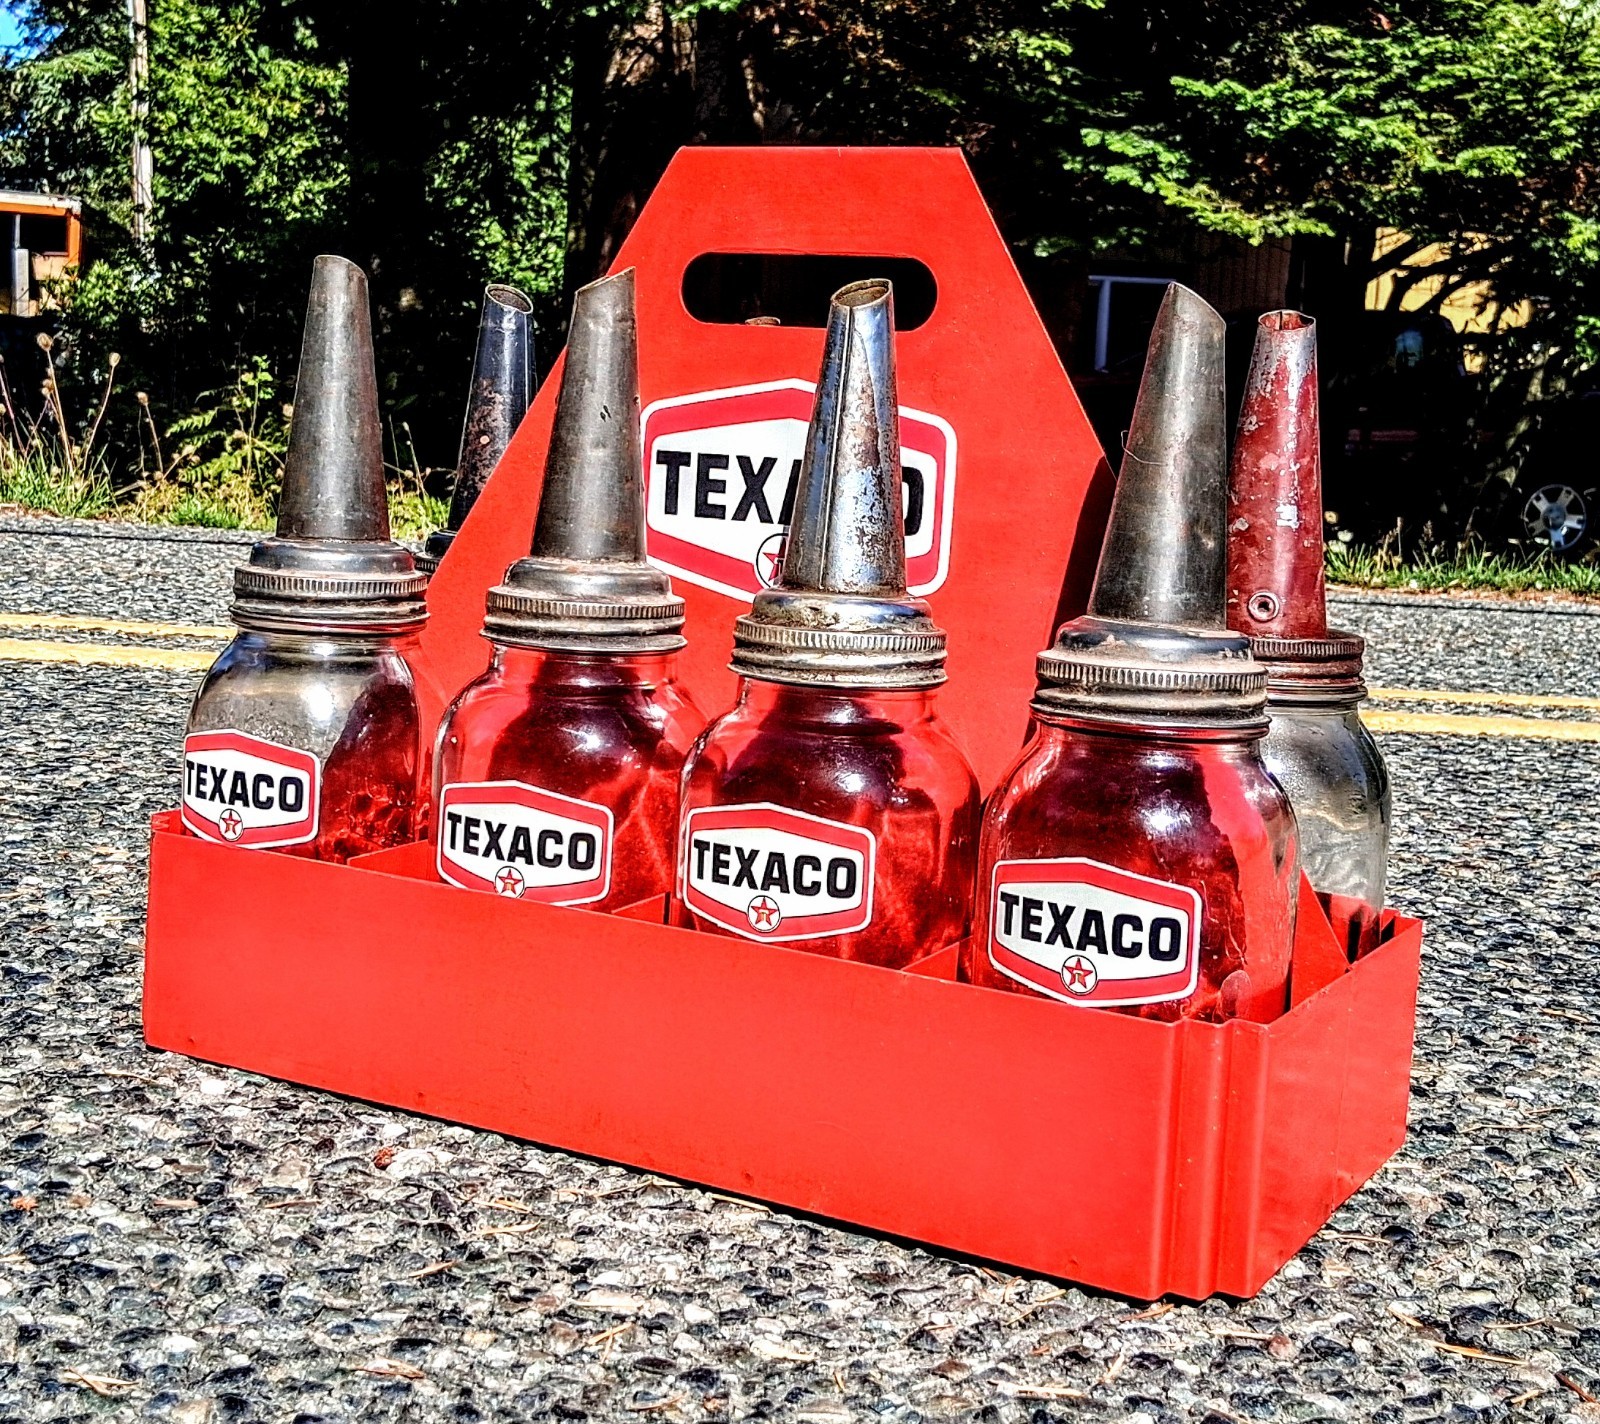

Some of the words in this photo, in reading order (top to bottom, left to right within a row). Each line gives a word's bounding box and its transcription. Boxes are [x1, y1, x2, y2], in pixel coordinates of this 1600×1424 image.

[656, 450, 924, 536] TEX
[186, 759, 304, 812] TEXACO
[447, 811, 596, 870] TEXACO
[693, 838, 857, 899] TEXACO
[1000, 891, 1181, 962] TEXACO
